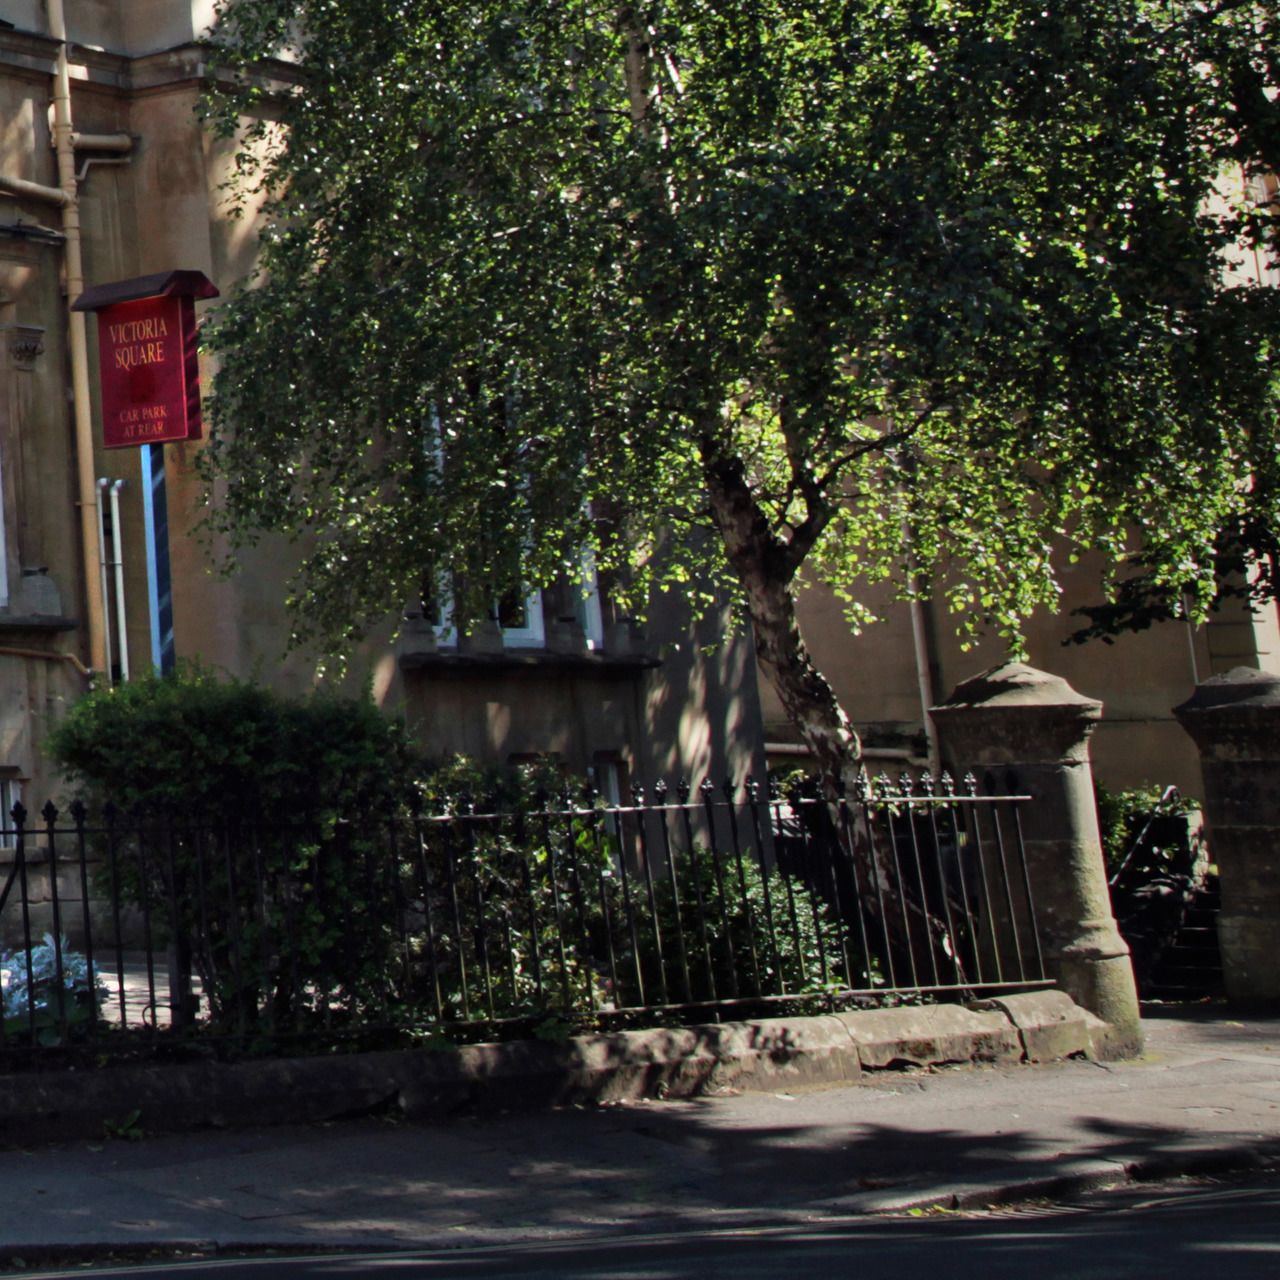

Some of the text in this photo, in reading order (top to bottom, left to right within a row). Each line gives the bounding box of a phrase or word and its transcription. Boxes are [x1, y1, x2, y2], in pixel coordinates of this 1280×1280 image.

[109, 317, 168, 344] VICTORIA
[115, 341, 165, 371] SQUARE
[120, 404, 167, 423] CAR PARK
[124, 421, 164, 438] AT REAR
